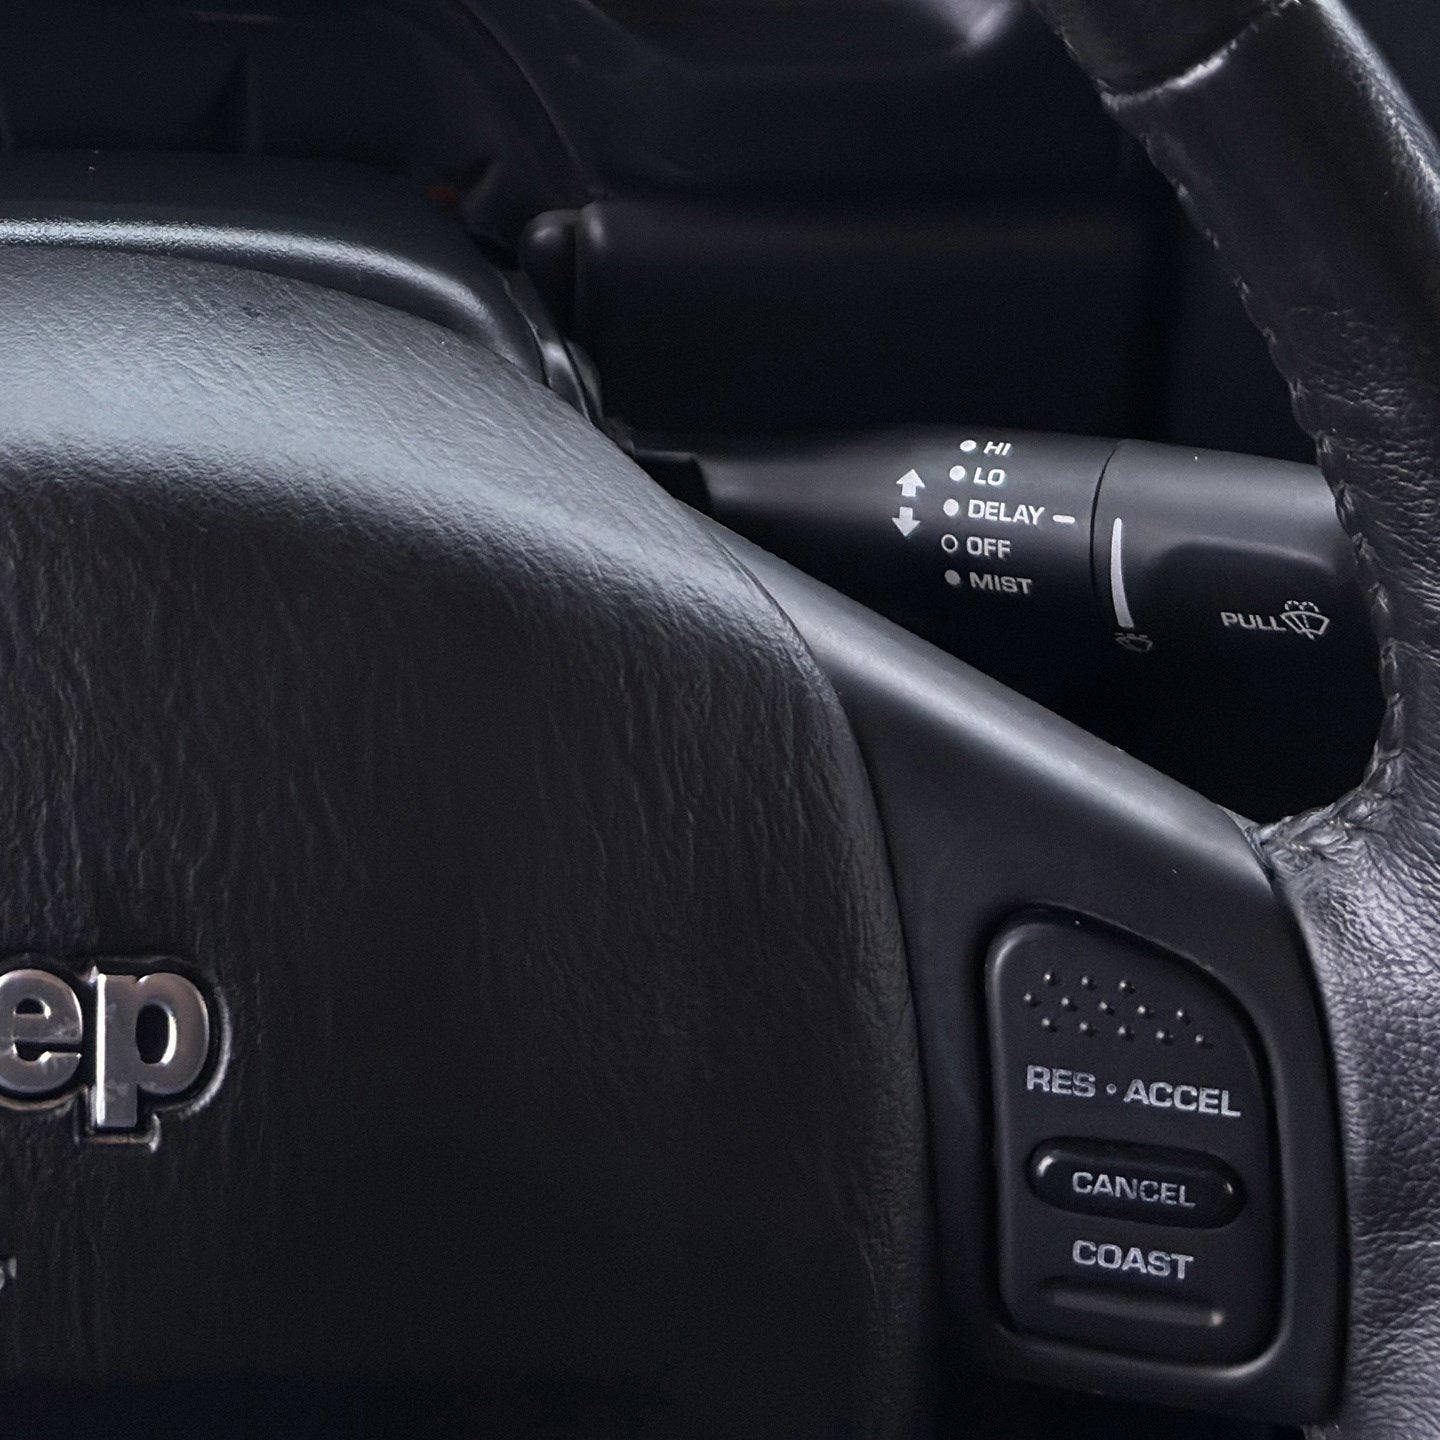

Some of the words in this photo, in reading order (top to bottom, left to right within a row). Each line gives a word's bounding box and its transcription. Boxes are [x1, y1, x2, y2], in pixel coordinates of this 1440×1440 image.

[983, 440, 1013, 457] HI
[972, 467, 1007, 487] LO
[967, 499, 1046, 525] DELAY
[966, 535, 1012, 560] OFF
[968, 571, 1033, 595] MIST
[1220, 610, 1287, 634] PULL
[1025, 1063, 1097, 1099] RES
[1123, 1078, 1242, 1118] ACCEL
[1071, 1170, 1197, 1208] CANCEL
[1071, 1239, 1195, 1280] COAST
